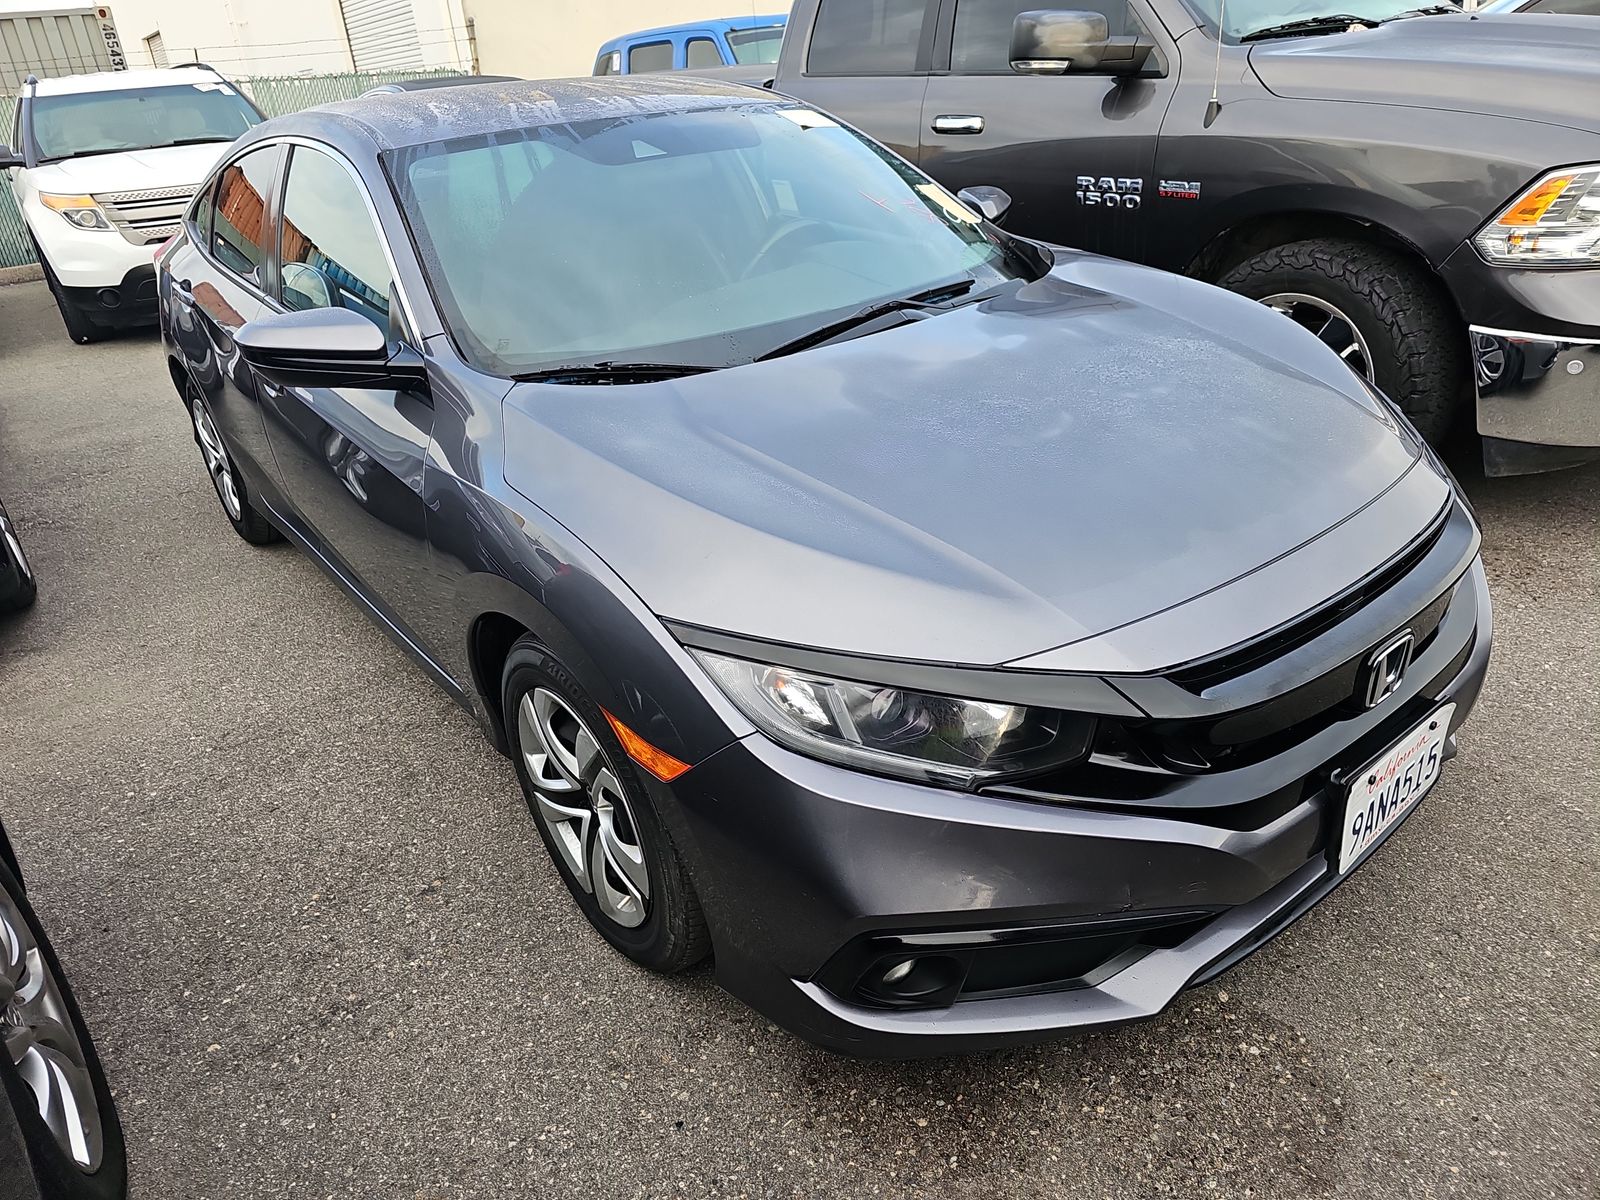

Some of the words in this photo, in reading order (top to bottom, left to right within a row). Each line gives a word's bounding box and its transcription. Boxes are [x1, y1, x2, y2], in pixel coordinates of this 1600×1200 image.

[1076, 175, 1143, 194] RAM
[1076, 191, 1141, 209] 1500
[1365, 733, 1431, 794] California
[1349, 739, 1440, 857] 9ANA515
